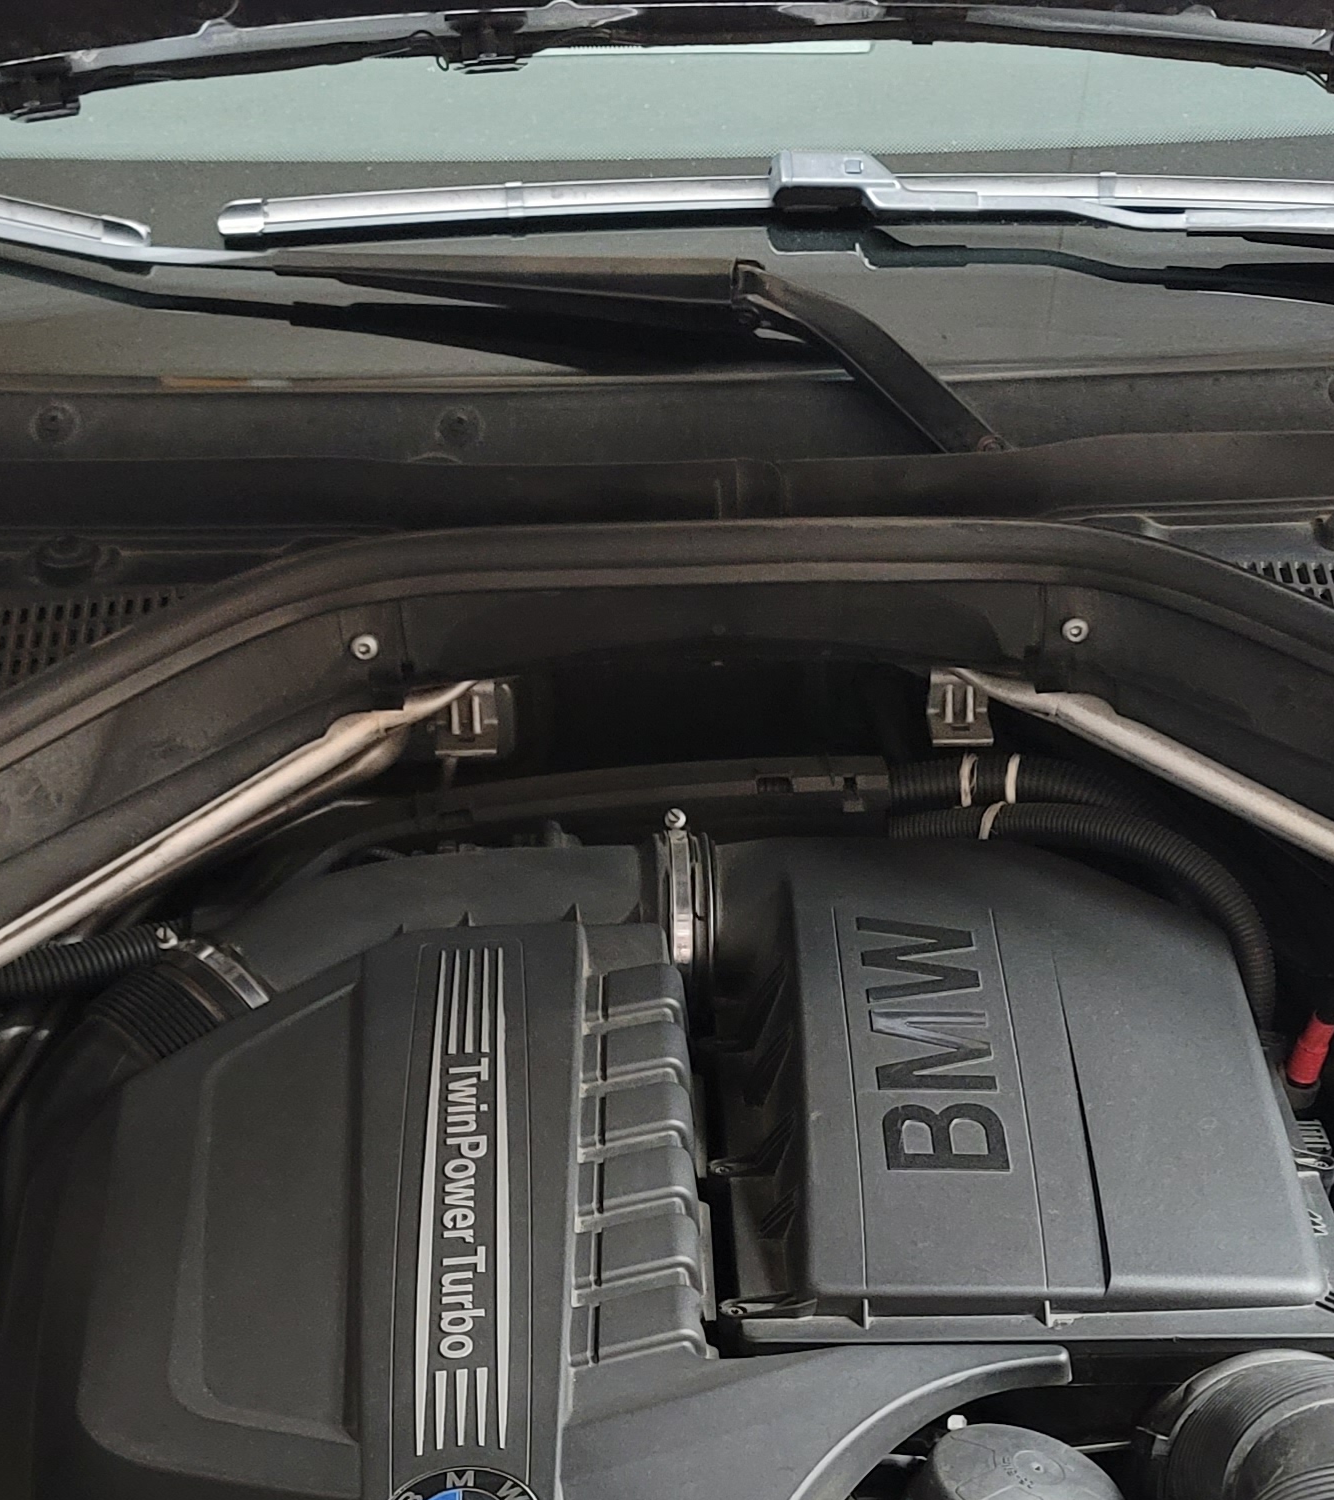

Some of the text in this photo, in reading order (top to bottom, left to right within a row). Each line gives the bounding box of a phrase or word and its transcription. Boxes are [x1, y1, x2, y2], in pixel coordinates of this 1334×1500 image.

[856, 917, 1012, 1171] BMW
[438, 1056, 490, 1359] TwinPower Turbo
